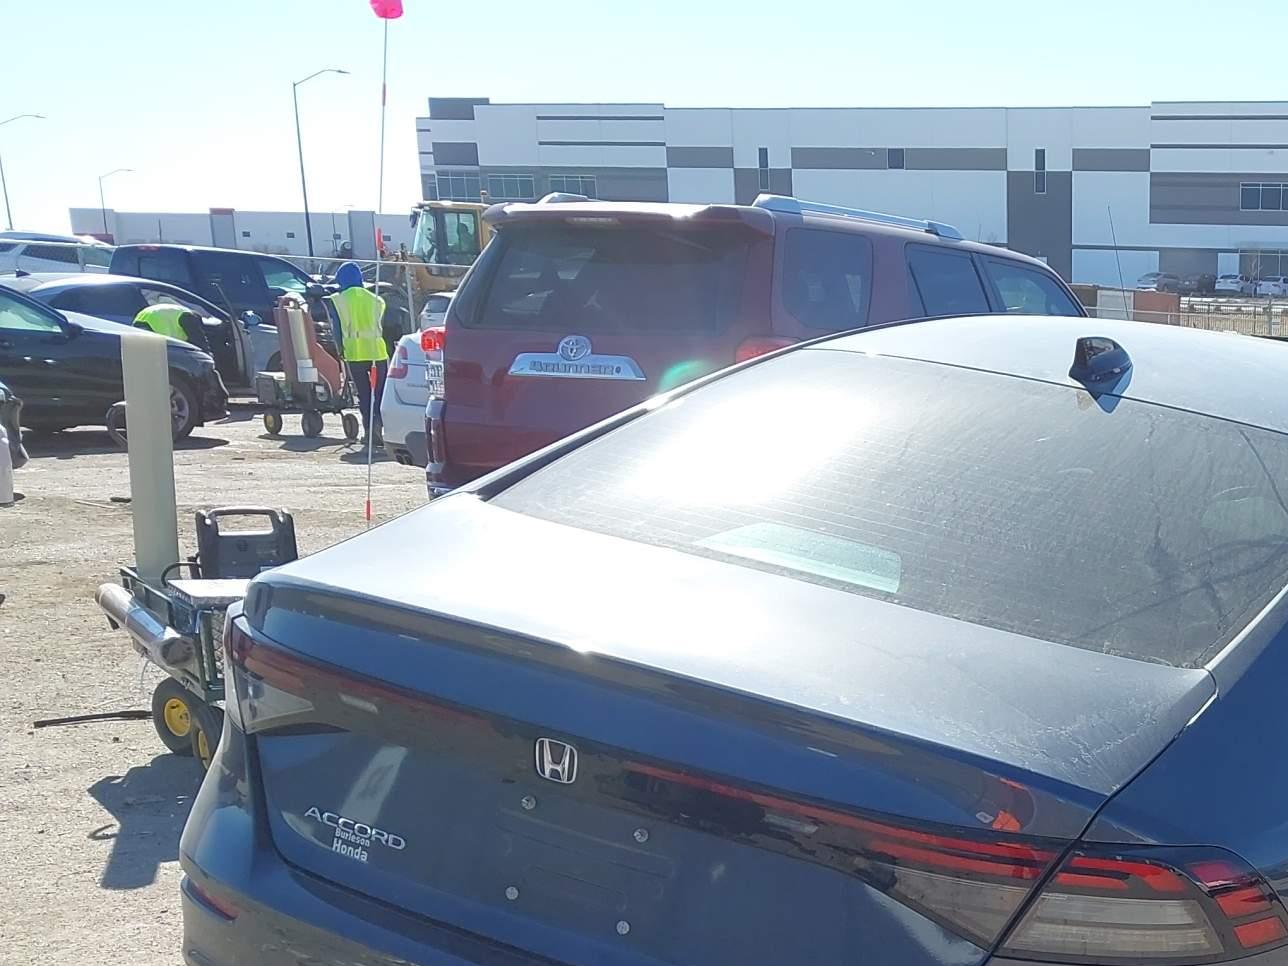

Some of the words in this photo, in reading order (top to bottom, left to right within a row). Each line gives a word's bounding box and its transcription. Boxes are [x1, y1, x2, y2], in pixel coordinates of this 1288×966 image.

[304, 806, 406, 850] ACCORD
[335, 827, 371, 847] Burleson
[332, 838, 369, 862] Honda
